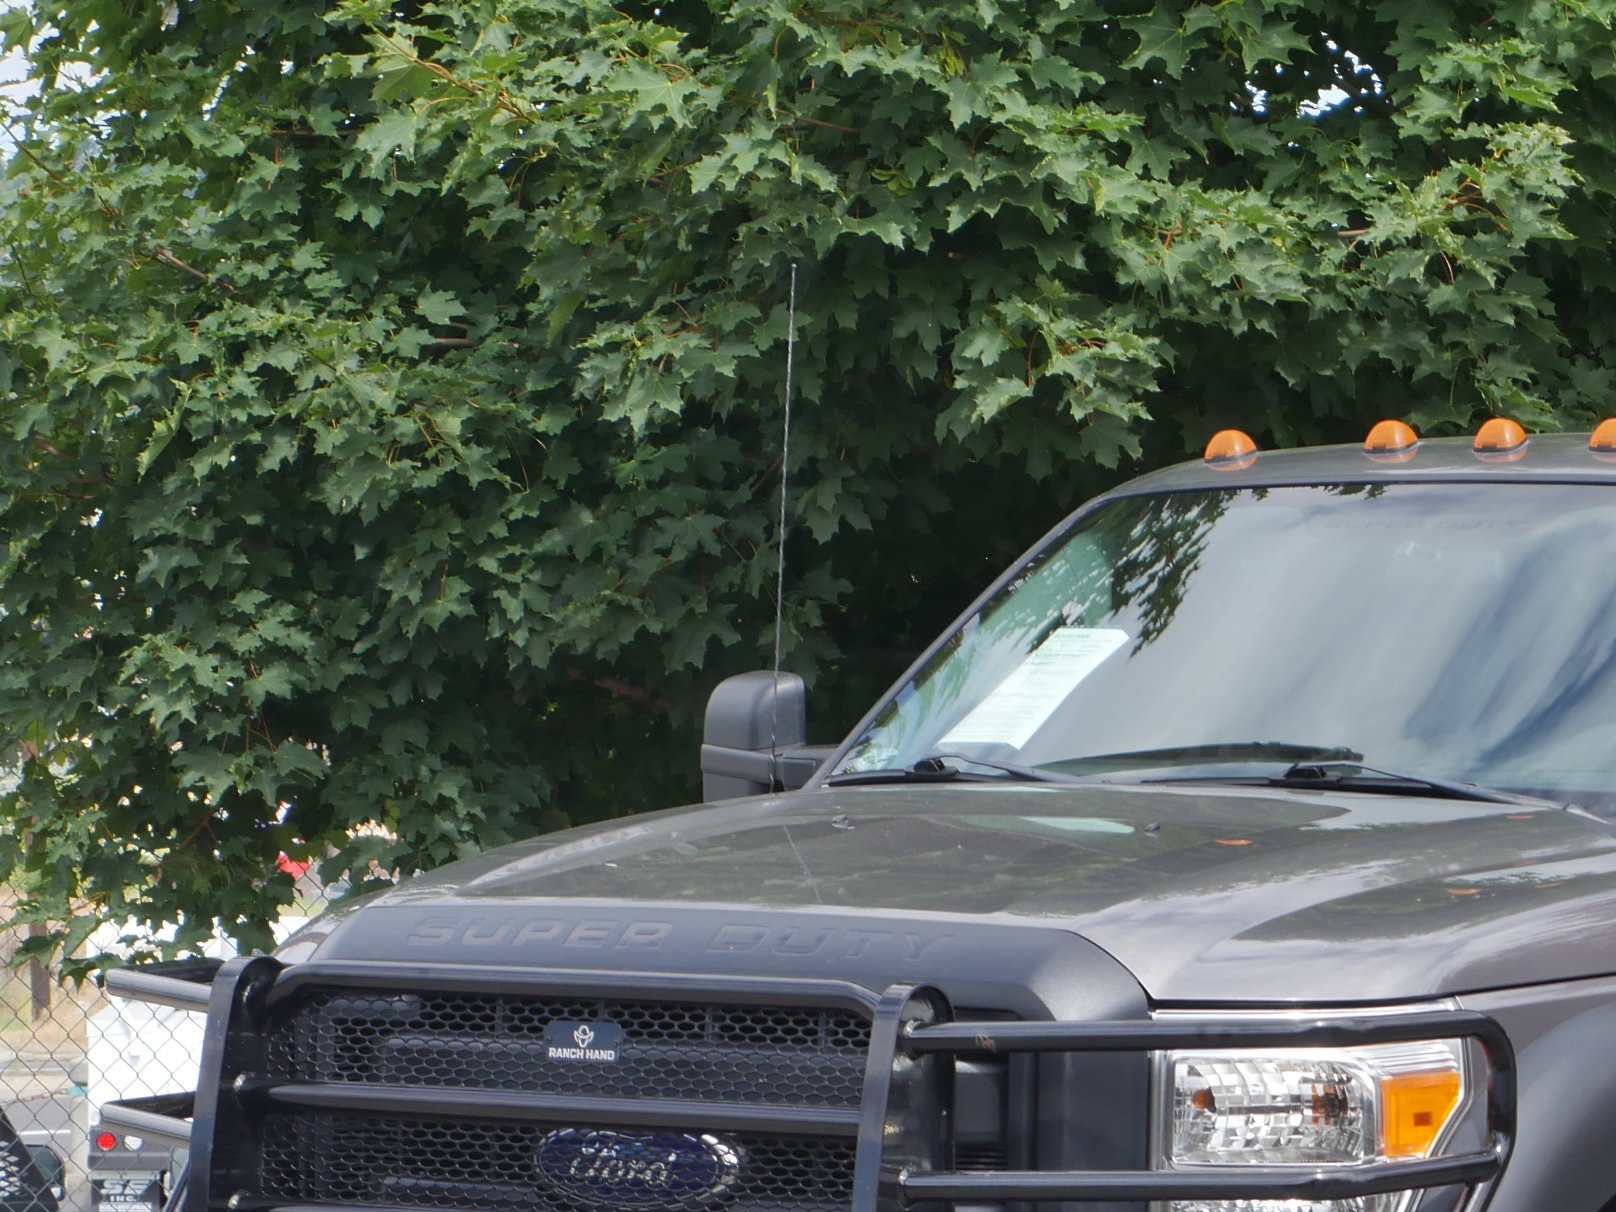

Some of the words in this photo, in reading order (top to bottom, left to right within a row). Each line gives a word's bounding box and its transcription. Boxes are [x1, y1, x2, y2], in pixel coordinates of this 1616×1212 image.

[408, 917, 673, 950] SUPER
[706, 923, 957, 961] DUTY
[548, 1047, 584, 1059] RANCH
[585, 1049, 615, 1060] HAND
